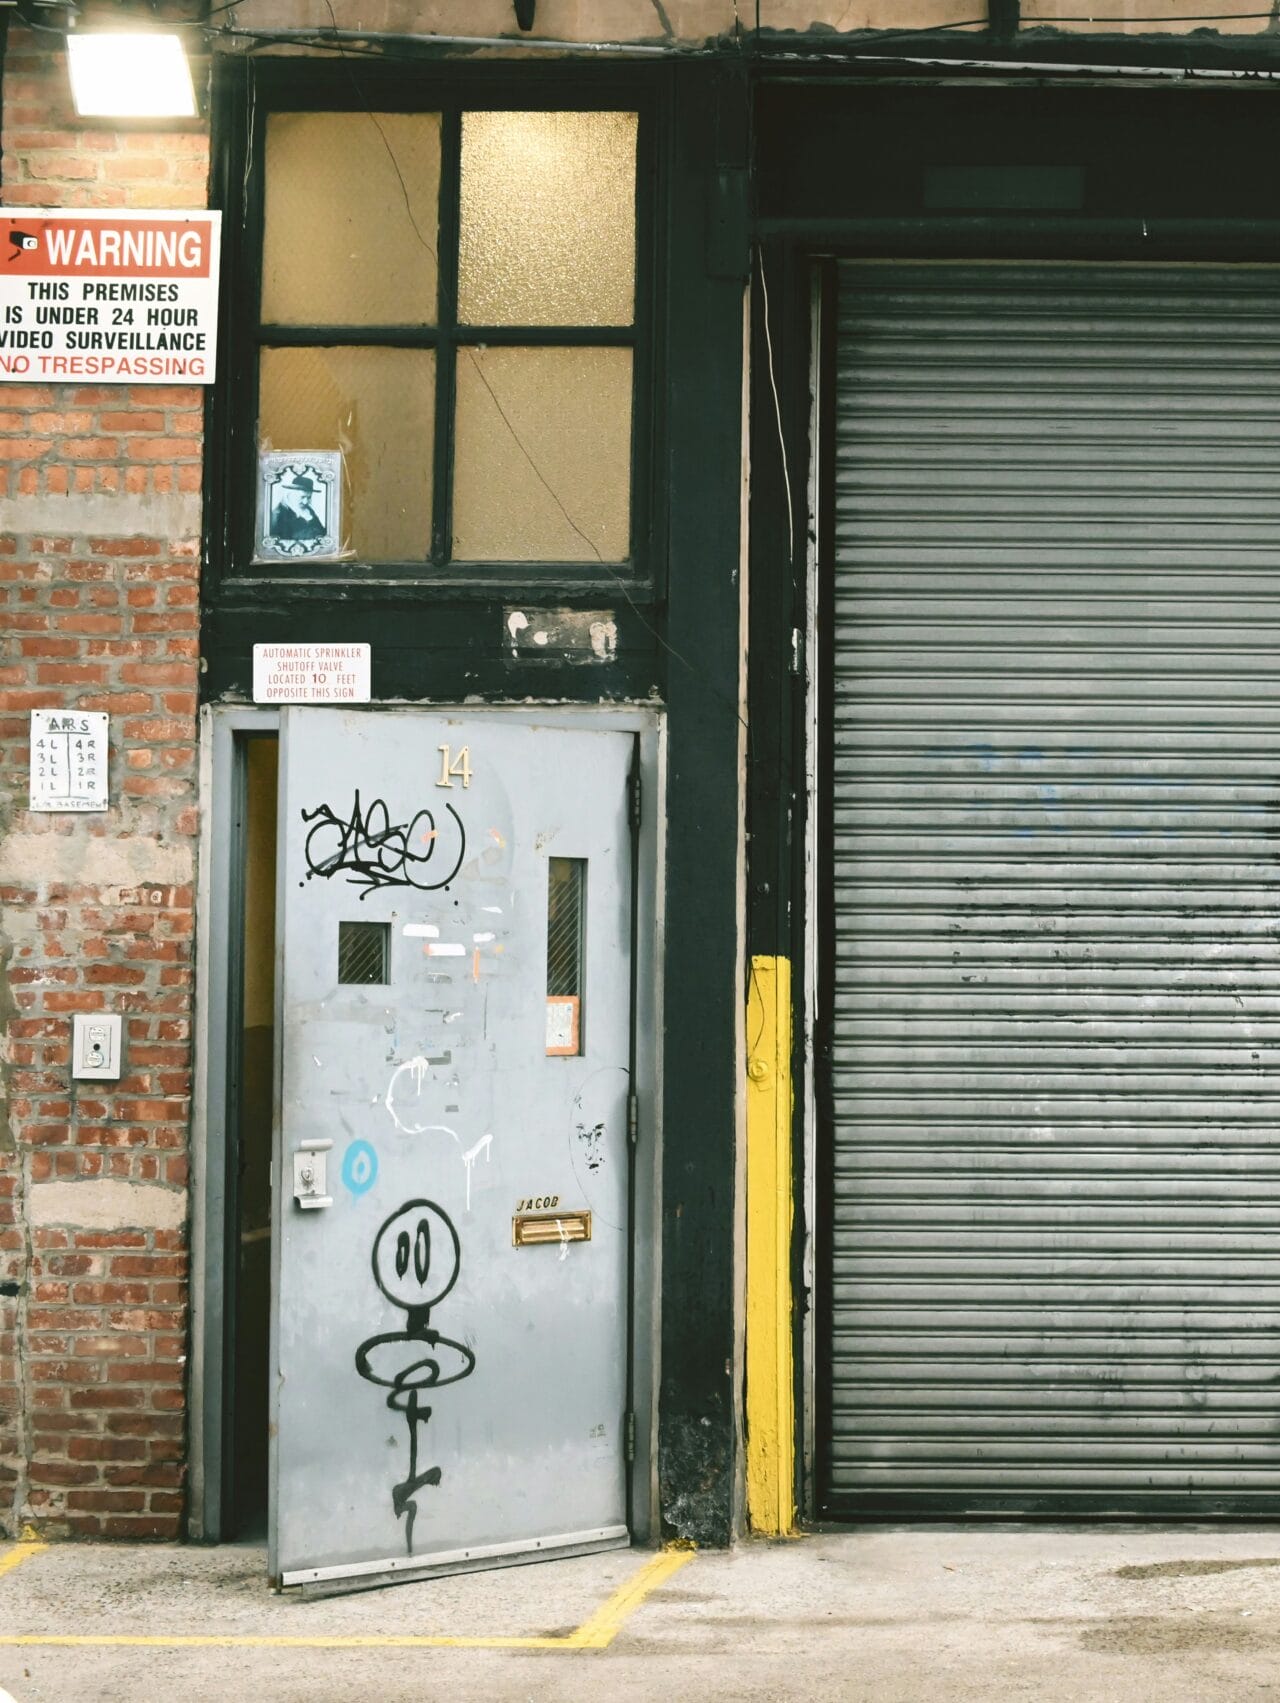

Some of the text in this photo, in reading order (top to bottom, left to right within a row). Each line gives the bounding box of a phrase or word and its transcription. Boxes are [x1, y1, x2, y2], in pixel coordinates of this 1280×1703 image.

[45, 229, 201, 268] WARNING
[28, 282, 179, 302] THIS PREMISES
[6, 306, 198, 326] IS UNDER 24 HOUR
[0, 330, 206, 351] VIDEO SURVEILLANCE
[38, 356, 205, 376] TRESPASSING
[263, 647, 362, 658] AUTOMATIC SPRINKLER
[277, 661, 344, 672] SHUTOFF VALVE
[268, 673, 356, 684] LOCATED 10 FEET
[266, 687, 354, 698] OPPOSITE THIS SIGN
[435, 744, 473, 789] 14
[516, 1195, 559, 1211] JACOB
